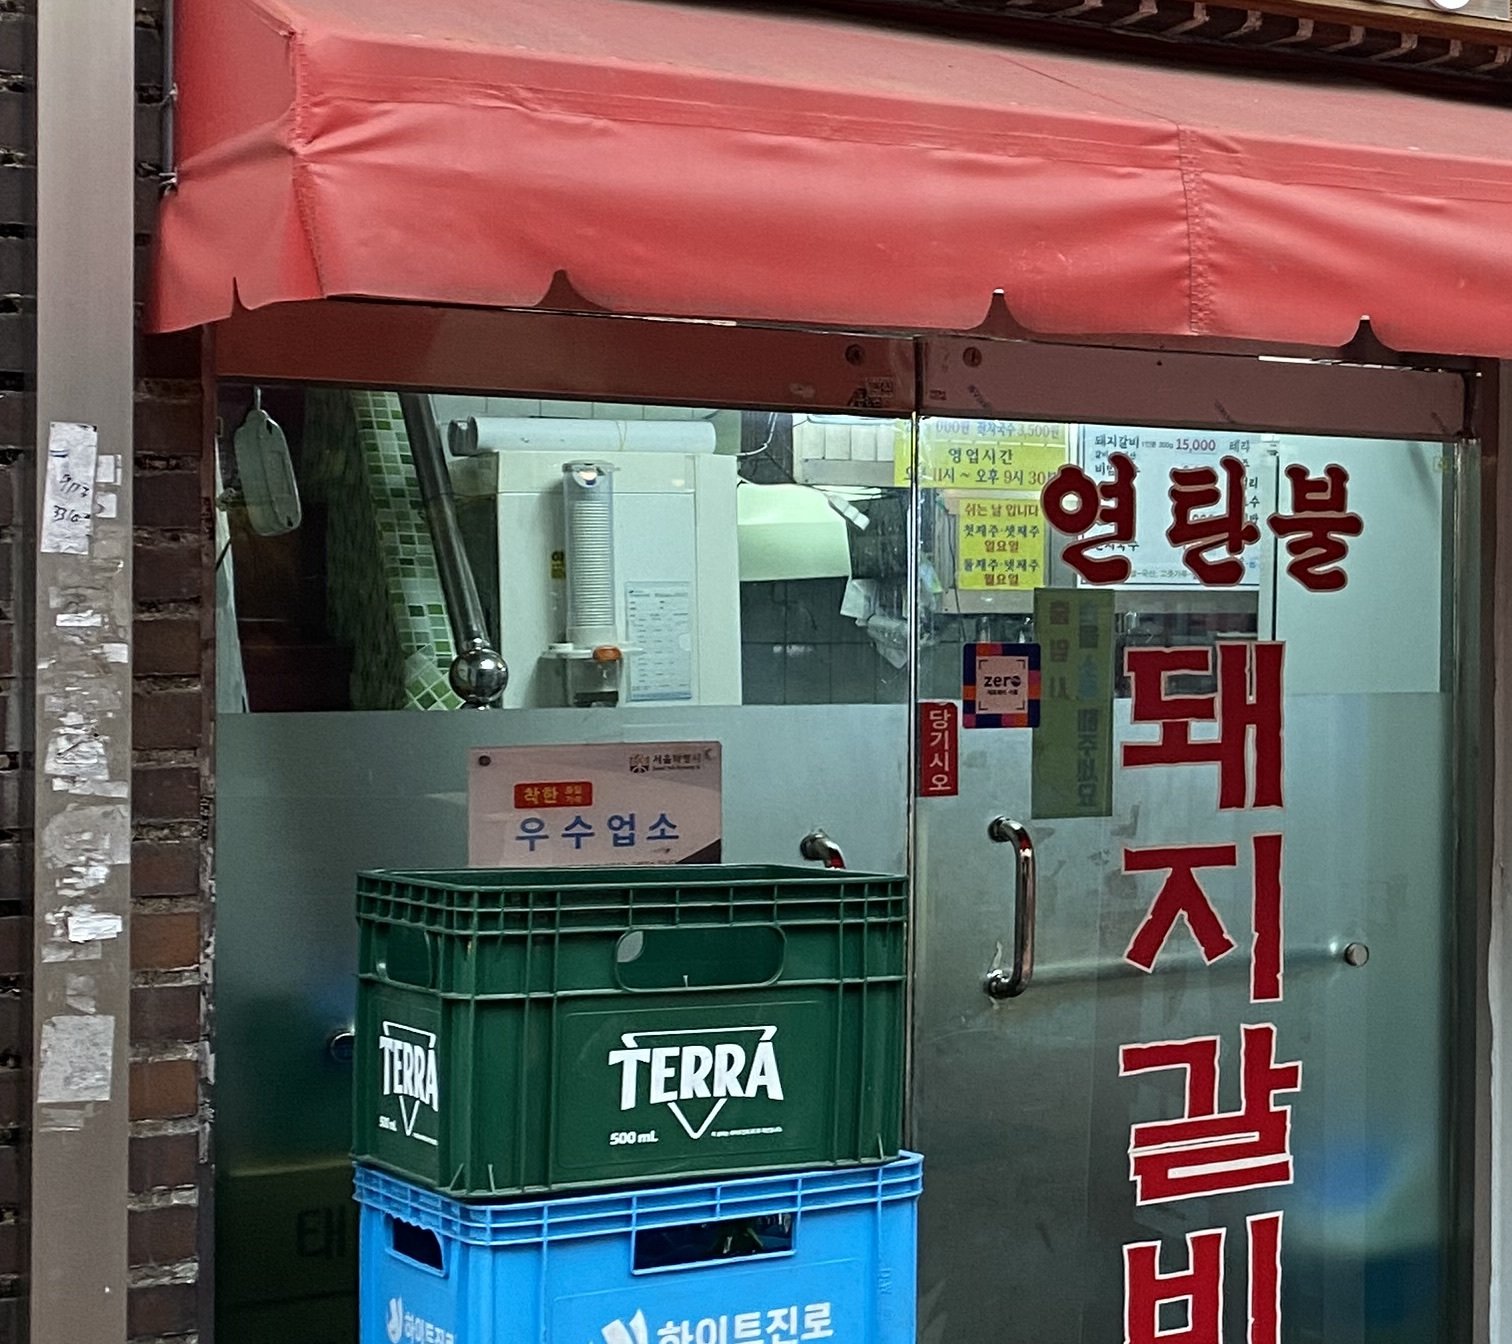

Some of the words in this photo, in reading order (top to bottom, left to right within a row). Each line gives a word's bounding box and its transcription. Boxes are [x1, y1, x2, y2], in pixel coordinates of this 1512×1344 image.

[1094, 434, 1140, 449] 돼지갈비
[1176, 438, 1216, 453] 15,000
[948, 447, 1015, 466] 영업시간
[975, 468, 1000, 485] 오후
[1003, 469, 1024, 486] 9시
[964, 502, 989, 517] 쉬는
[1005, 503, 1040, 518] 입니다
[1040, 452, 1364, 593] 연탄불
[983, 675, 1022, 688] zero
[928, 709, 952, 791] 당기시오
[515, 812, 680, 852] 우수업소
[379, 1034, 439, 1113] TERRA
[607, 1039, 784, 1111] TERRA
[609, 1131, 637, 1146] 500
[638, 1130, 659, 1144] mL
